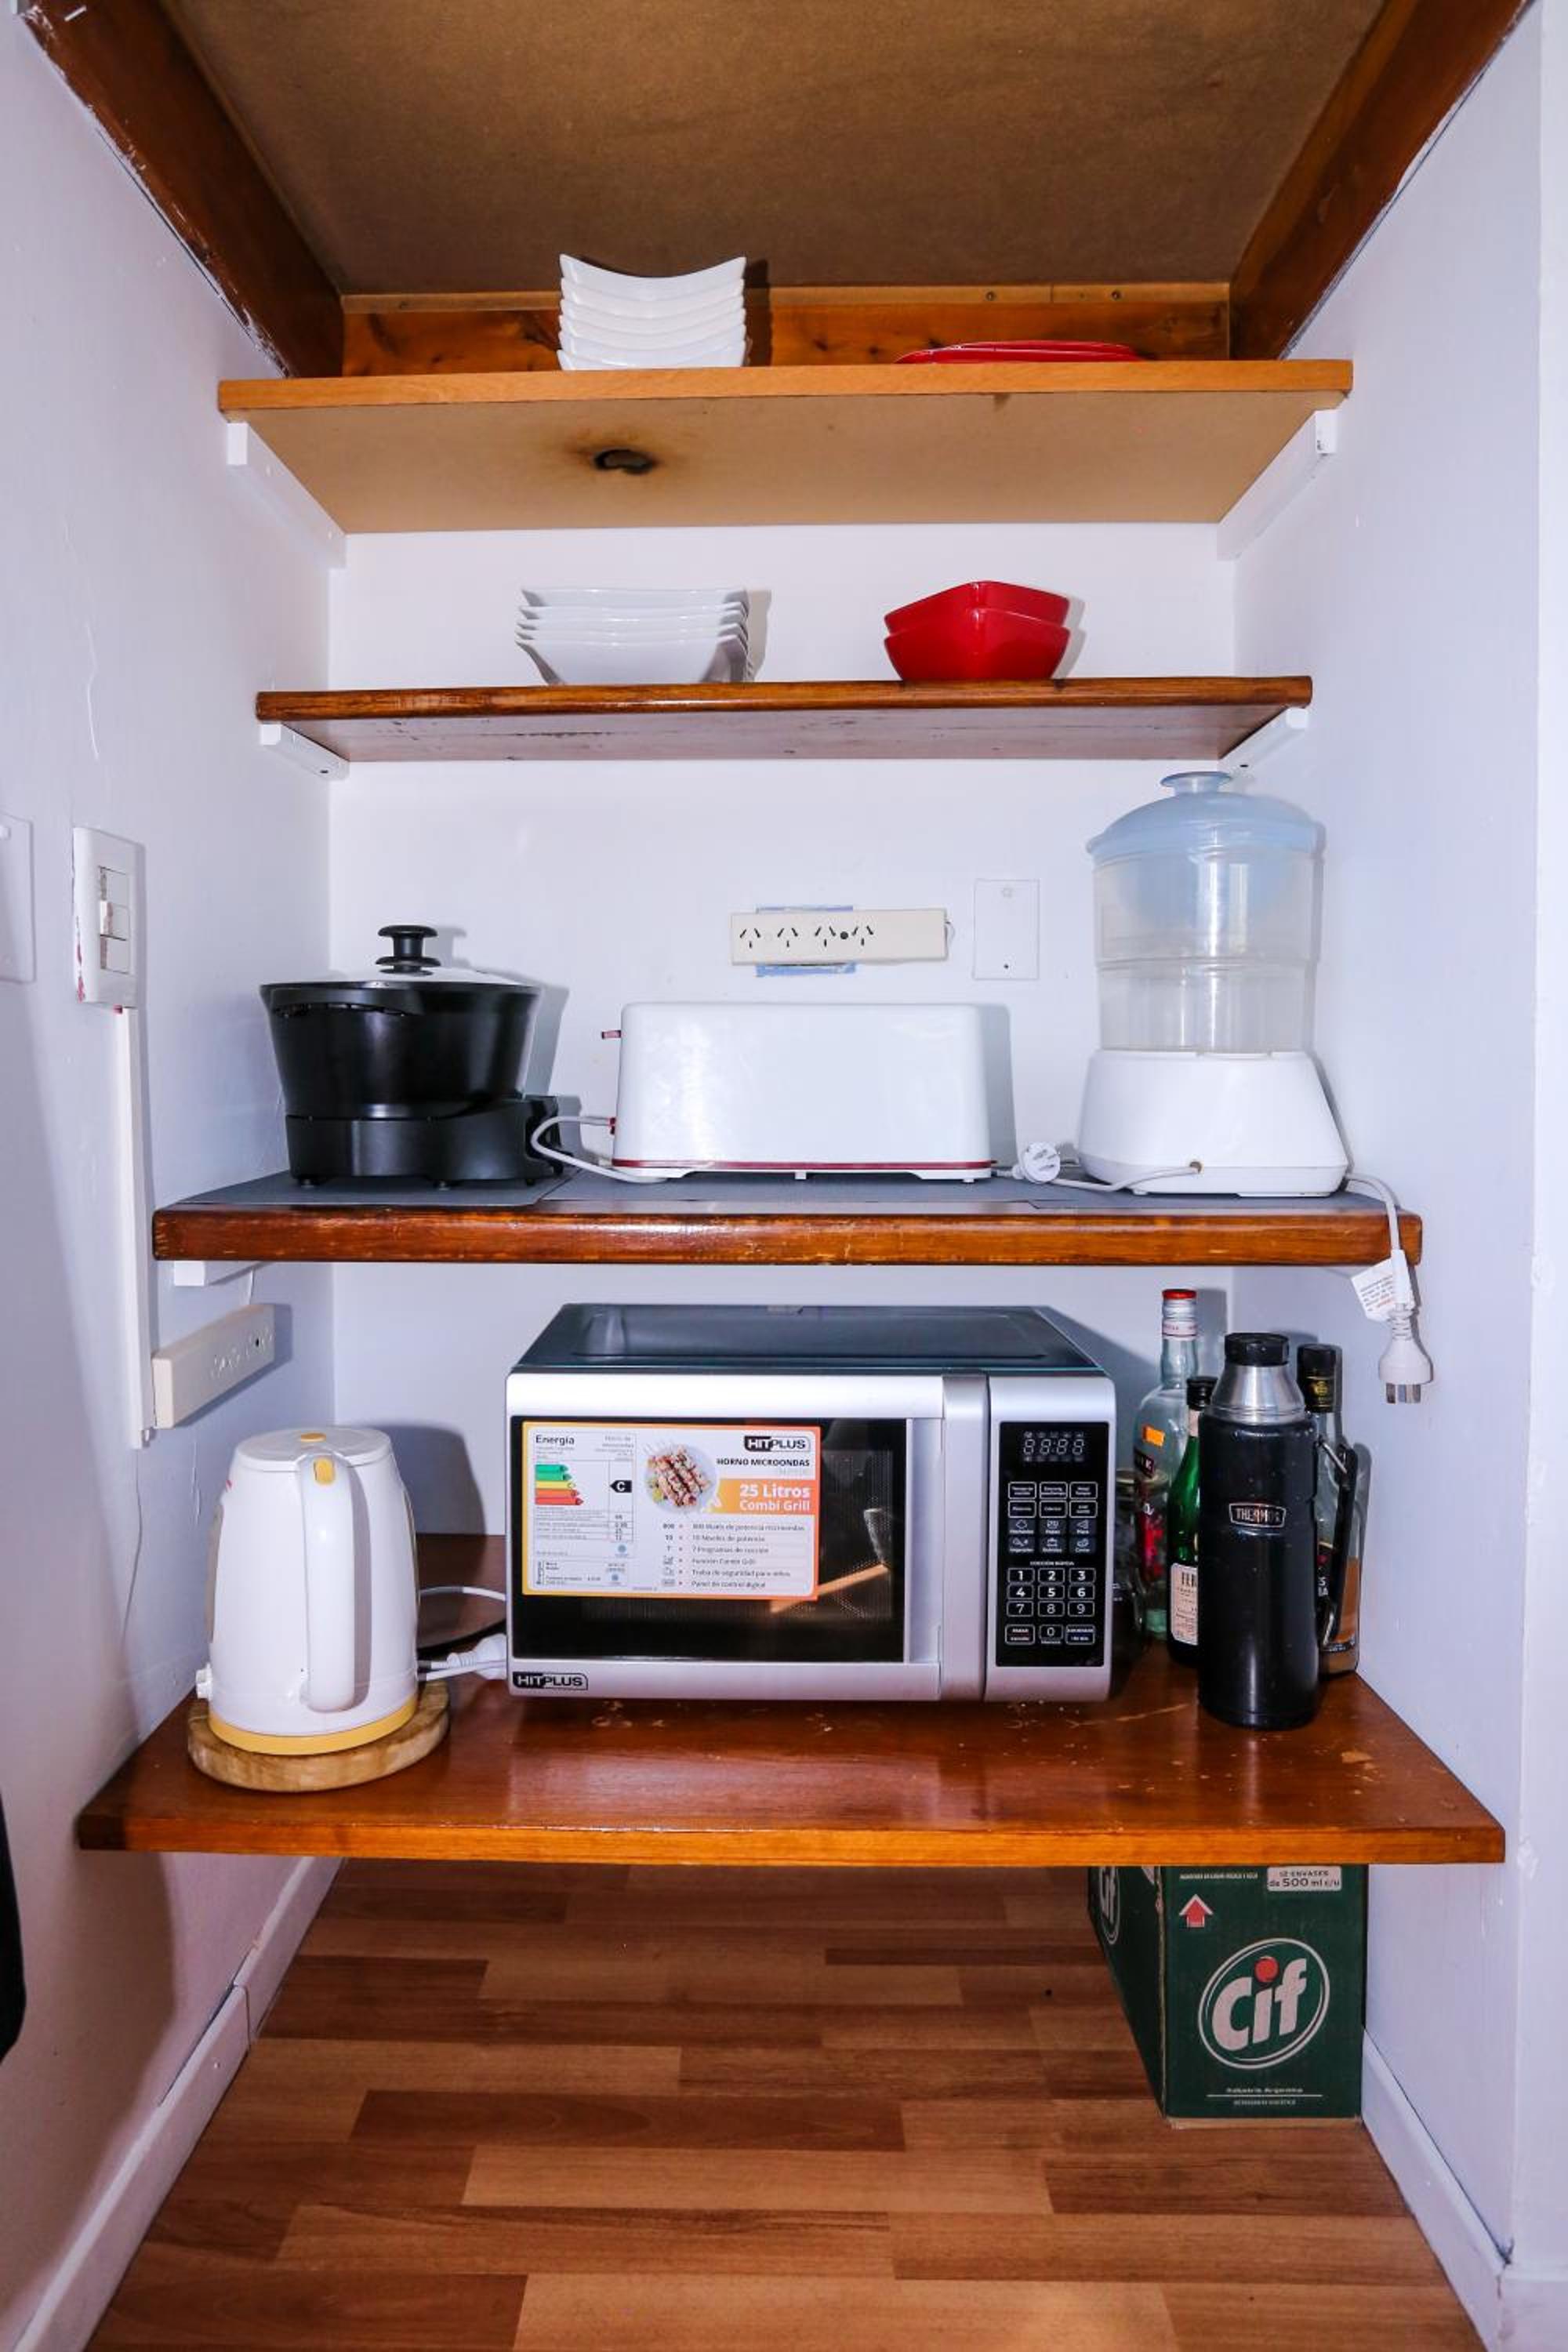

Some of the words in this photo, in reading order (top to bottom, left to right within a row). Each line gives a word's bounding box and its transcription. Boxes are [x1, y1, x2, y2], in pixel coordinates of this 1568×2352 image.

[746, 1438, 807, 1450] HITPLUS
[616, 1481, 626, 1492] C
[739, 1483, 758, 1497] 25
[763, 1483, 810, 1498] Litros
[739, 1499, 781, 1511] Combi
[783, 1499, 810, 1512] Grill
[1018, 1570, 1023, 1581] 1
[1048, 1570, 1056, 1581] 2
[1078, 1570, 1086, 1581] 3
[1016, 1587, 1026, 1597] 4
[1047, 1588, 1056, 1597] 5
[1077, 1588, 1086, 1597] 6
[1016, 1603, 1025, 1613] 7
[1047, 1603, 1055, 1614] 8
[1076, 1603, 1086, 1613] 9
[1047, 1627, 1054, 1636] 0
[516, 1674, 585, 1688] HITPLUS
[1282, 1878, 1308, 1887] 500
[1211, 1955, 1307, 2051] Cif
